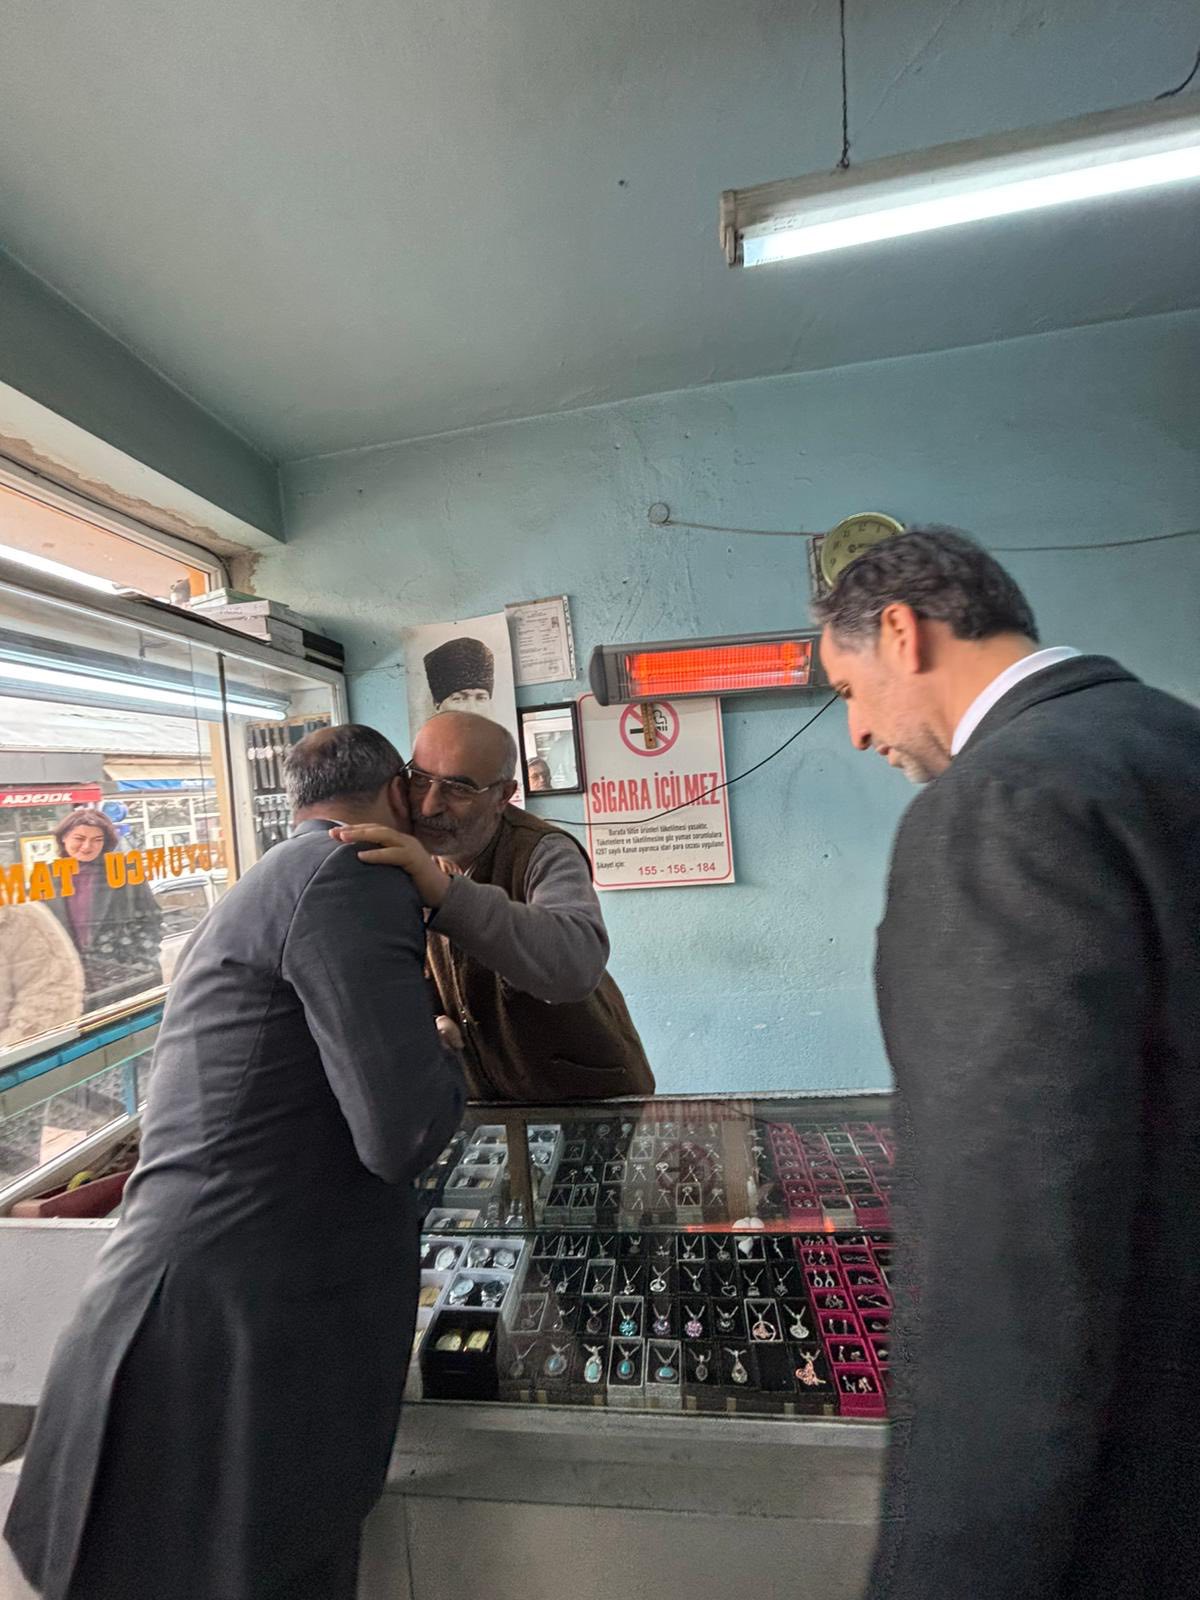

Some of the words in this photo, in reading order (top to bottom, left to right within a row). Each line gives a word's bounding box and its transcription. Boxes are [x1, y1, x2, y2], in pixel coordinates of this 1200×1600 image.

[591, 776, 652, 814] SİGARA
[654, 770, 720, 811] İÇİLMEZ
[639, 865, 657, 875] 155
[667, 863, 686, 874] 156
[697, 862, 716, 873] 184
